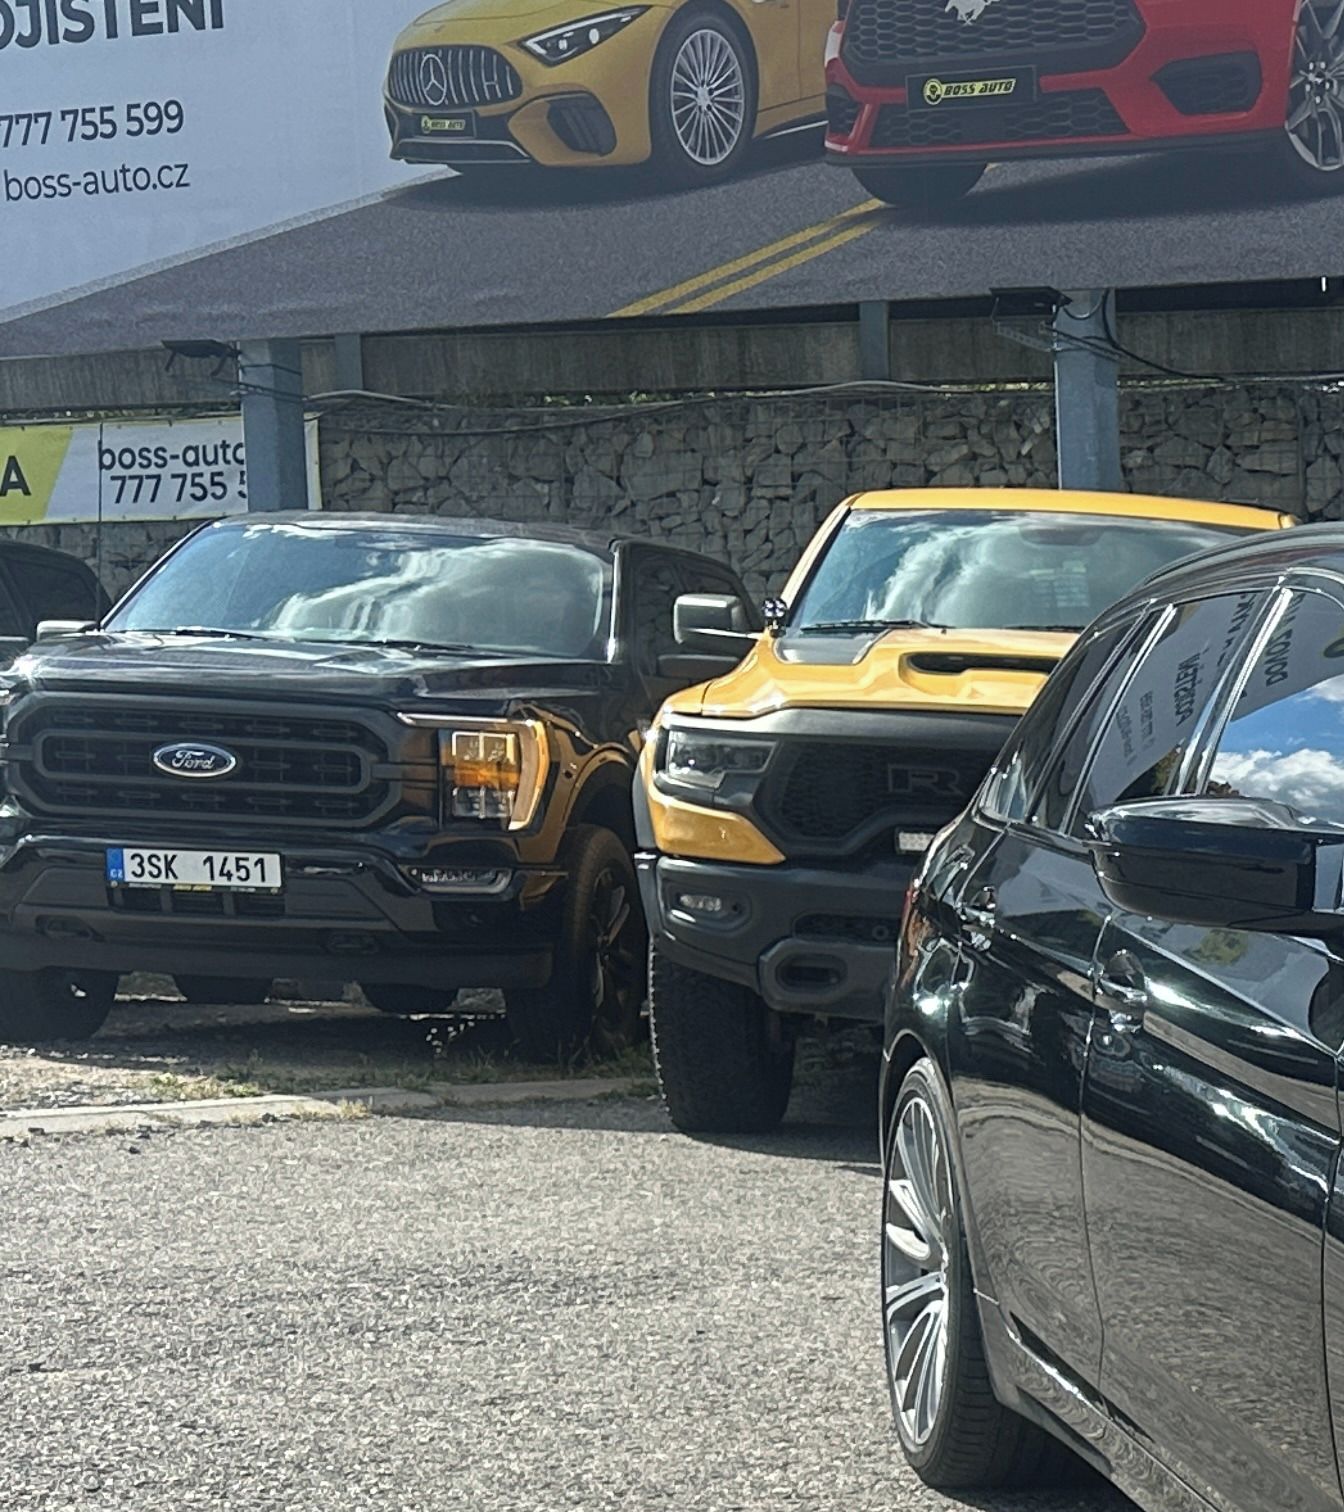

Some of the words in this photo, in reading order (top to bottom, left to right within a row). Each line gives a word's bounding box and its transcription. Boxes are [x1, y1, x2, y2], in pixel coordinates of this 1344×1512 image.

[943, 84, 976, 96] BOSS
[978, 80, 1013, 94] AUTO
[0, 111, 52, 148] 777
[60, 106, 118, 142] 755
[126, 100, 184, 137] 599
[4, 163, 191, 201] boss-auto.cz
[110, 473, 162, 504] 777
[170, 471, 228, 502] 755
[171, 750, 215, 770] Ford
[129, 852, 179, 880] 3SK
[202, 855, 267, 883] 1451
